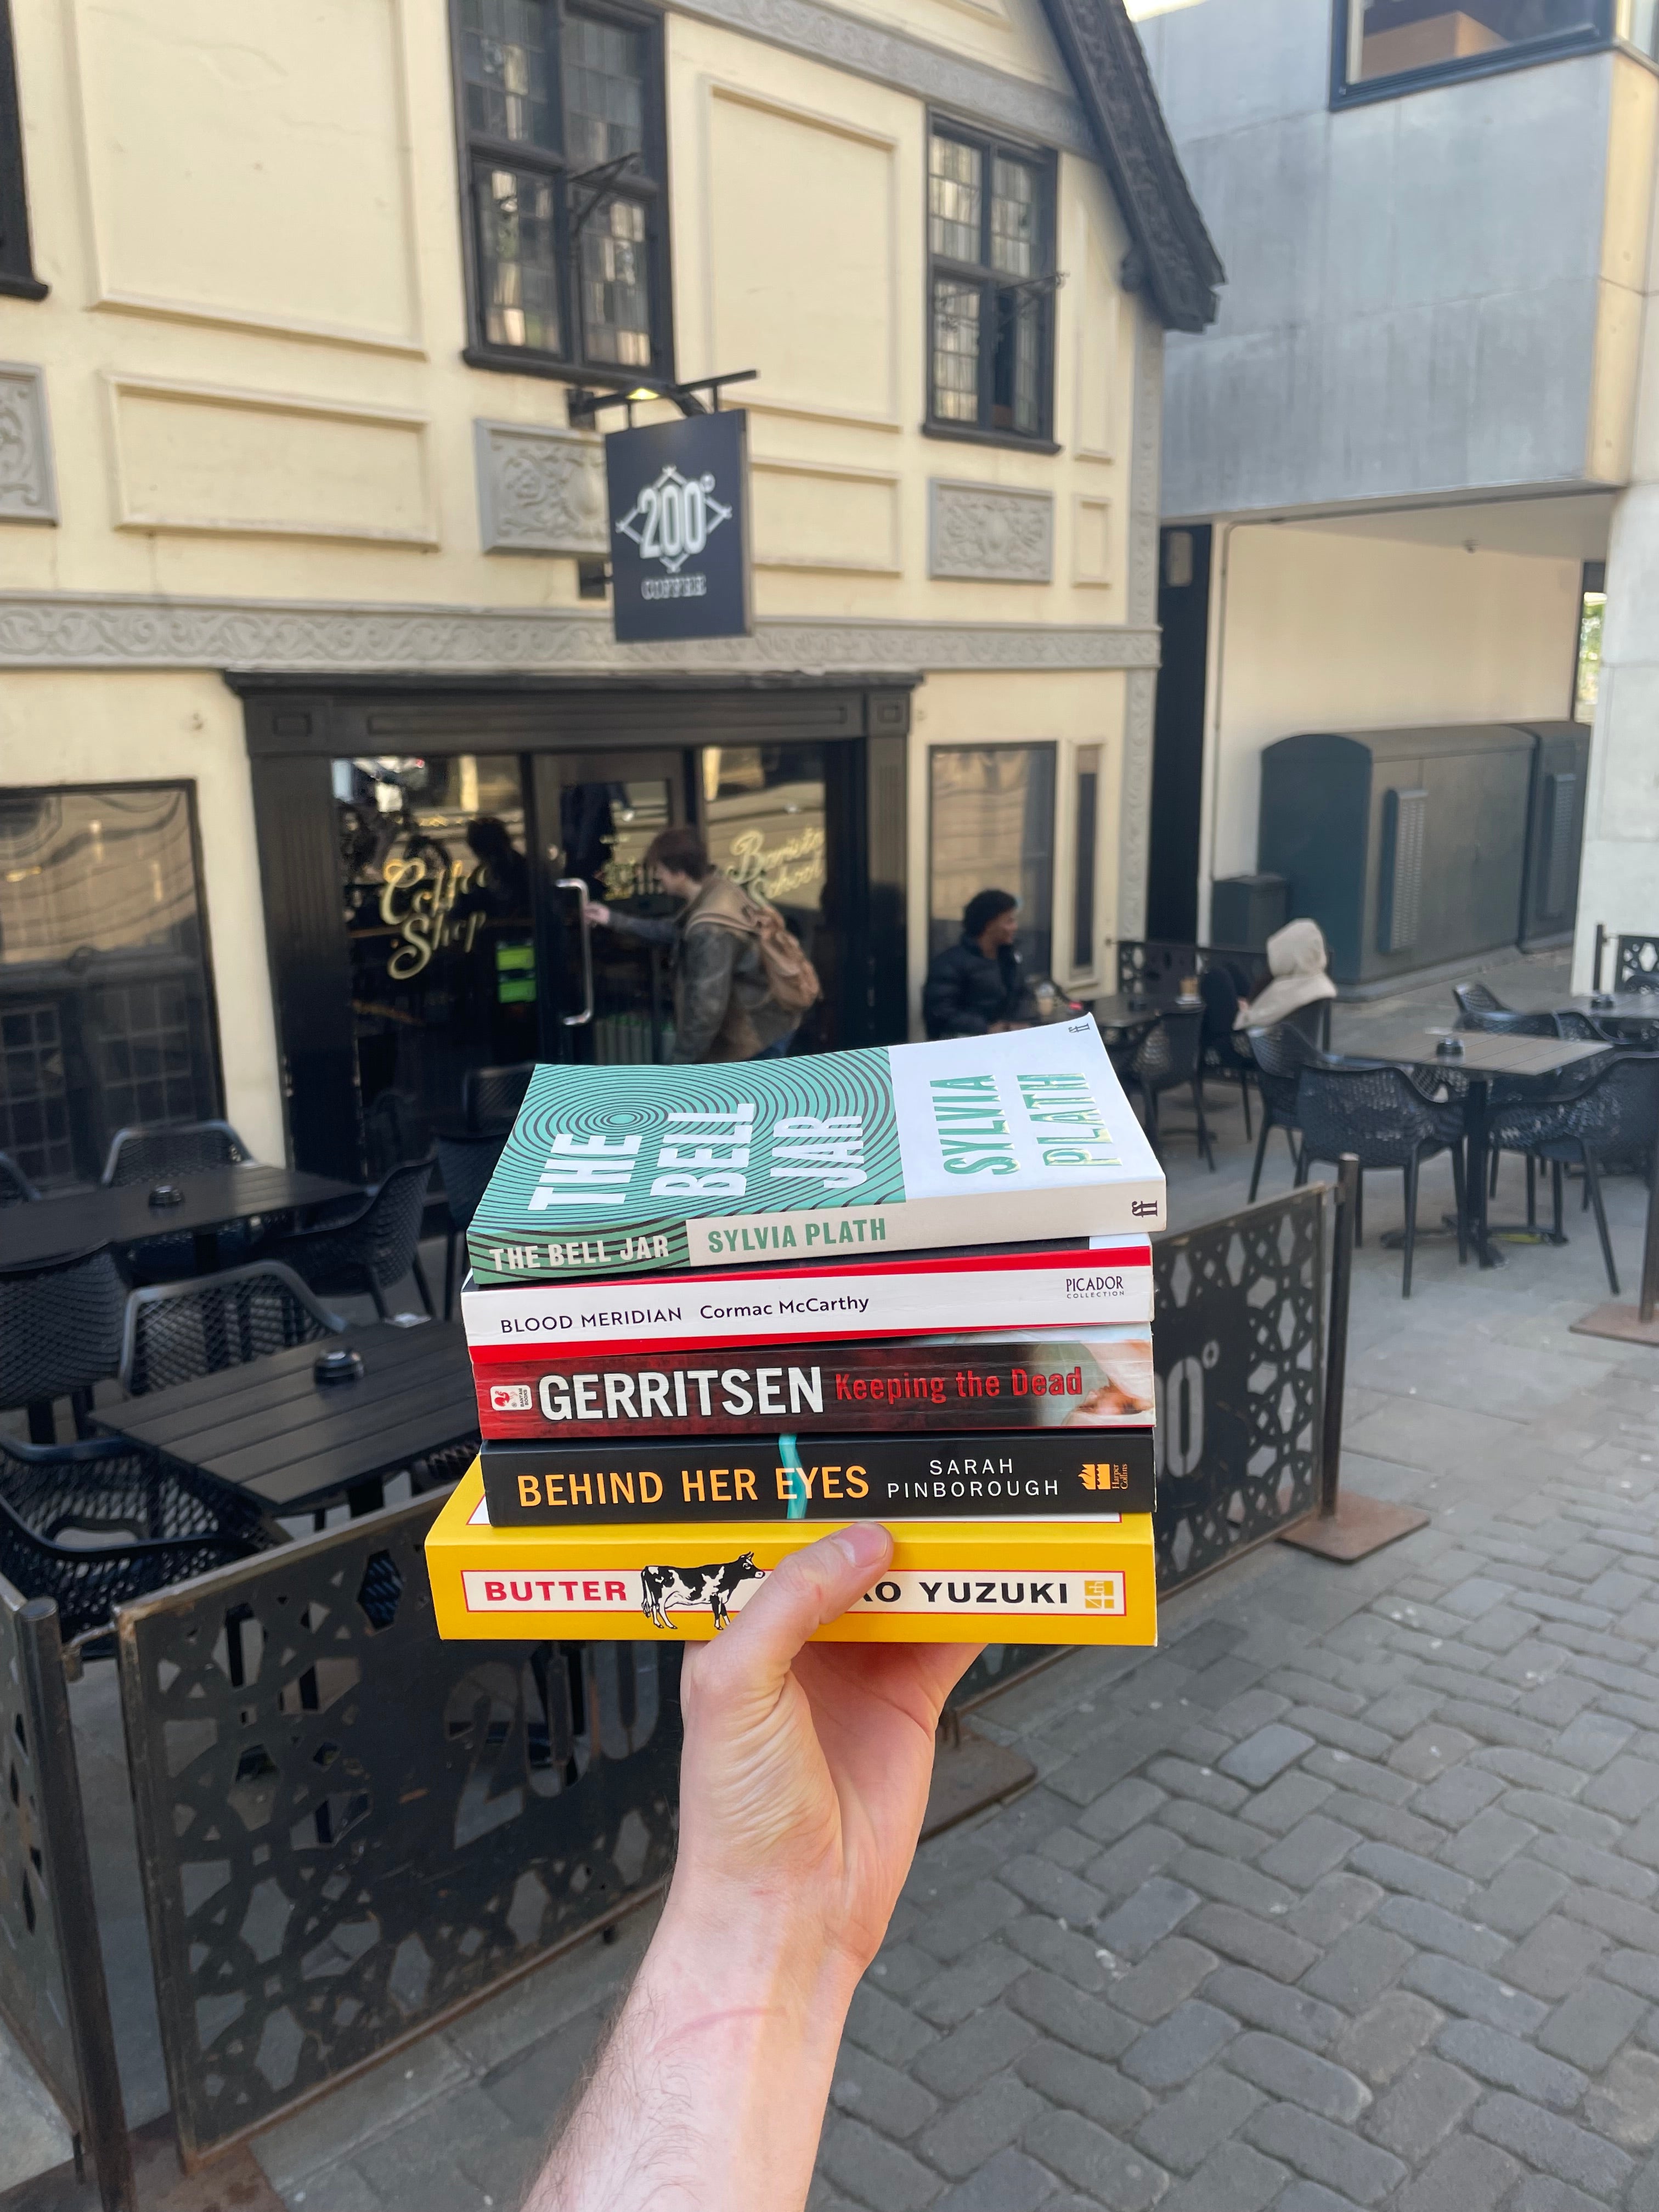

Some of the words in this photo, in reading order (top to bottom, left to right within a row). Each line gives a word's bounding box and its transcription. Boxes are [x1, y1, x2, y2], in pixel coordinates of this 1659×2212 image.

[641, 574, 707, 600] COFFEE
[930, 1074, 1022, 1175] SYLVIA
[1017, 1073, 1123, 1166] PLATH
[650, 1103, 755, 1196] BELL
[770, 1116, 868, 1189] JAR
[527, 1133, 642, 1211] THE
[489, 1245, 541, 1271] THE
[549, 1240, 612, 1266] BELL
[620, 1234, 669, 1259] JAR
[708, 1225, 797, 1253] SYLVIA
[806, 1218, 886, 1246] PLATH
[1066, 1276, 1124, 1291] PICADOR
[1066, 1291, 1124, 1299] COLLECTION
[500, 1315, 573, 1334] BLOOD
[582, 1307, 682, 1328] MERIDIAN
[699, 1302, 772, 1319] Cormac
[780, 1295, 870, 1314] McCarthy
[539, 1366, 824, 1420] GERRITSEN
[835, 1372, 946, 1404] Keeping
[955, 1370, 1000, 1397] the
[1011, 1366, 1083, 1396] Dead
[929, 1458, 1013, 1475] SARAH
[1111, 1464, 1120, 1489] Harper
[1120, 1464, 1128, 1489] Collins
[518, 1470, 663, 1508] BEHIND
[681, 1468, 758, 1502] HER
[775, 1465, 870, 1500] EYES
[887, 1480, 1059, 1499] PINBOROUGH
[484, 1581, 627, 1601] BUTTER
[918, 1582, 1068, 1604] YUZUKI
